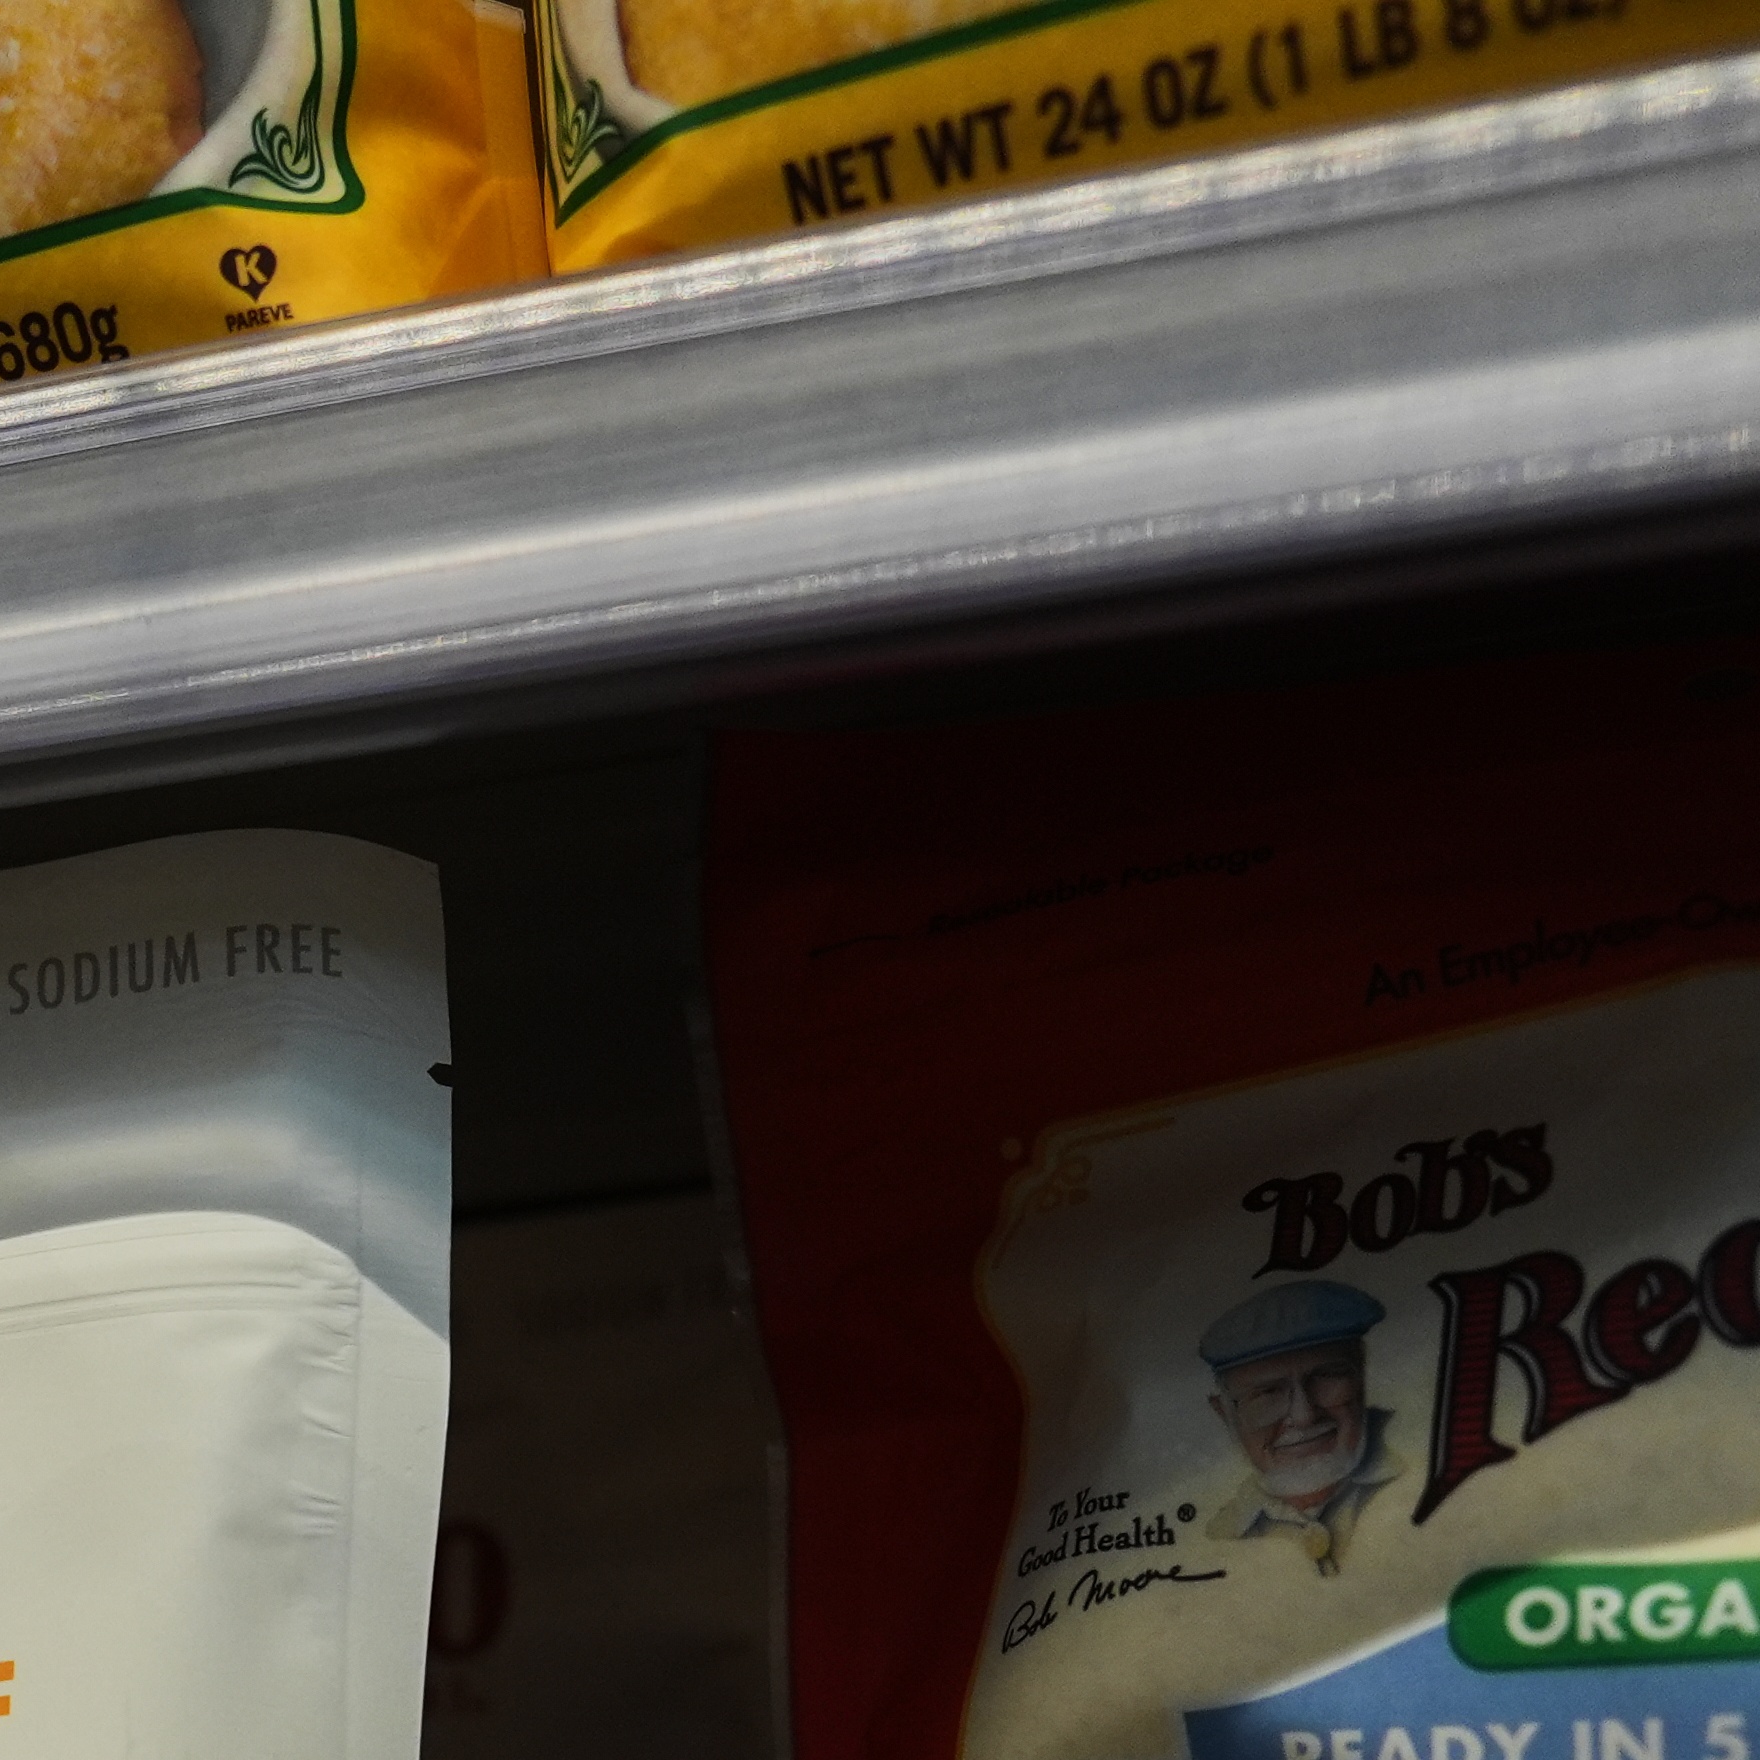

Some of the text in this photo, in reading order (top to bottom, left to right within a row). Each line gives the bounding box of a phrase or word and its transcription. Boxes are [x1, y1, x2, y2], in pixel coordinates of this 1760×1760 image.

[782, 135, 895, 225] NET
[916, 104, 1013, 190] WT
[1035, 82, 1123, 162] 24
[1143, 48, 1229, 132] OZ
[1246, 22, 1310, 108] (1
[1338, 0, 1421, 81] LB
[224, 301, 294, 335] PAREVE
[1119, 844, 1277, 892] Package
[7, 930, 201, 1016] SODIUM
[224, 921, 344, 978] FREE
[1363, 961, 1428, 1007] An
[1241, 1121, 1556, 1281] Bob's
[1047, 1487, 1131, 1532] To Your
[1017, 1531, 1069, 1578] Good
